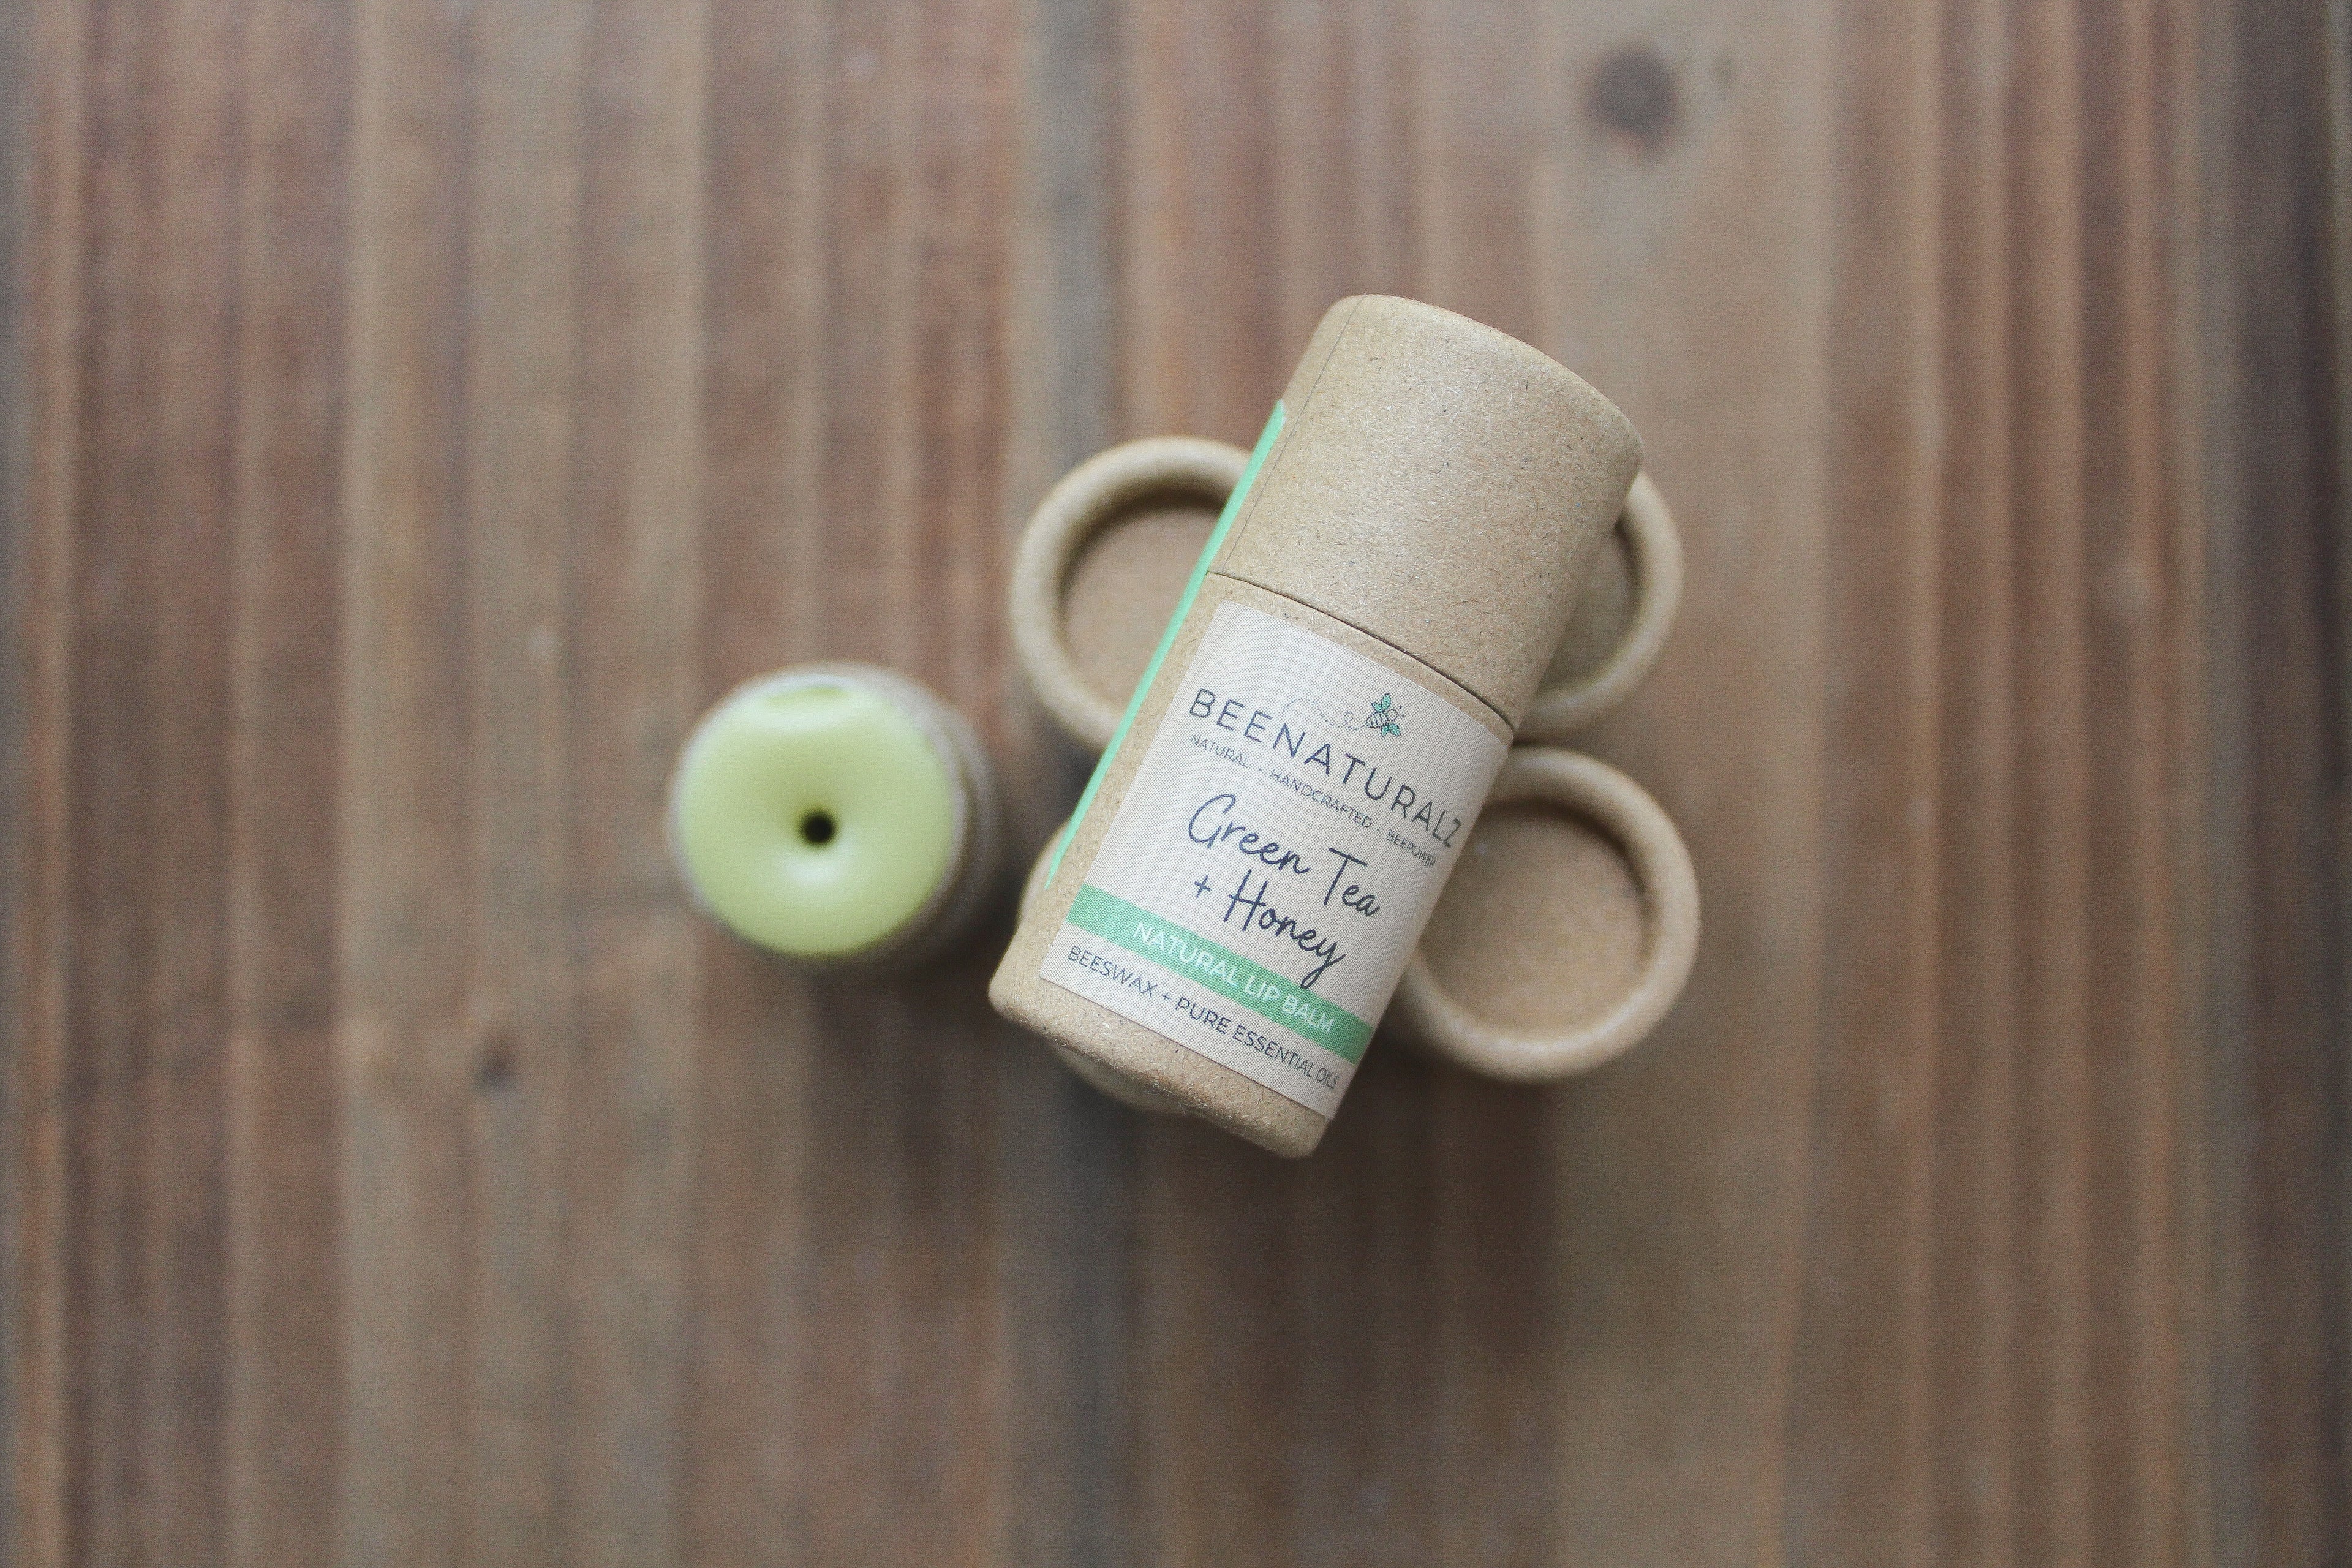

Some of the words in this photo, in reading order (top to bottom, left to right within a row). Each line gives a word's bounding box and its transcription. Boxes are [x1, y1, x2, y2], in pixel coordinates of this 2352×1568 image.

[1189, 688, 1462, 848] BEENATURALZ
[1190, 734, 1248, 768] NATURAL
[1269, 769, 1373, 829] HANDCRAFTED
[1188, 793, 1310, 875] Green
[1322, 847, 1380, 917] Tea
[1132, 922, 1238, 986] NATURAL
[1244, 976, 1280, 1003] LIP
[1281, 994, 1335, 1035] BALM
[1223, 869, 1347, 989] Honey
[1068, 944, 1153, 999] BEESWAX
[1174, 997, 1231, 1035] PURE
[1232, 1025, 1313, 1078] ESSENTIAL
[1316, 1068, 1340, 1089] OILS
